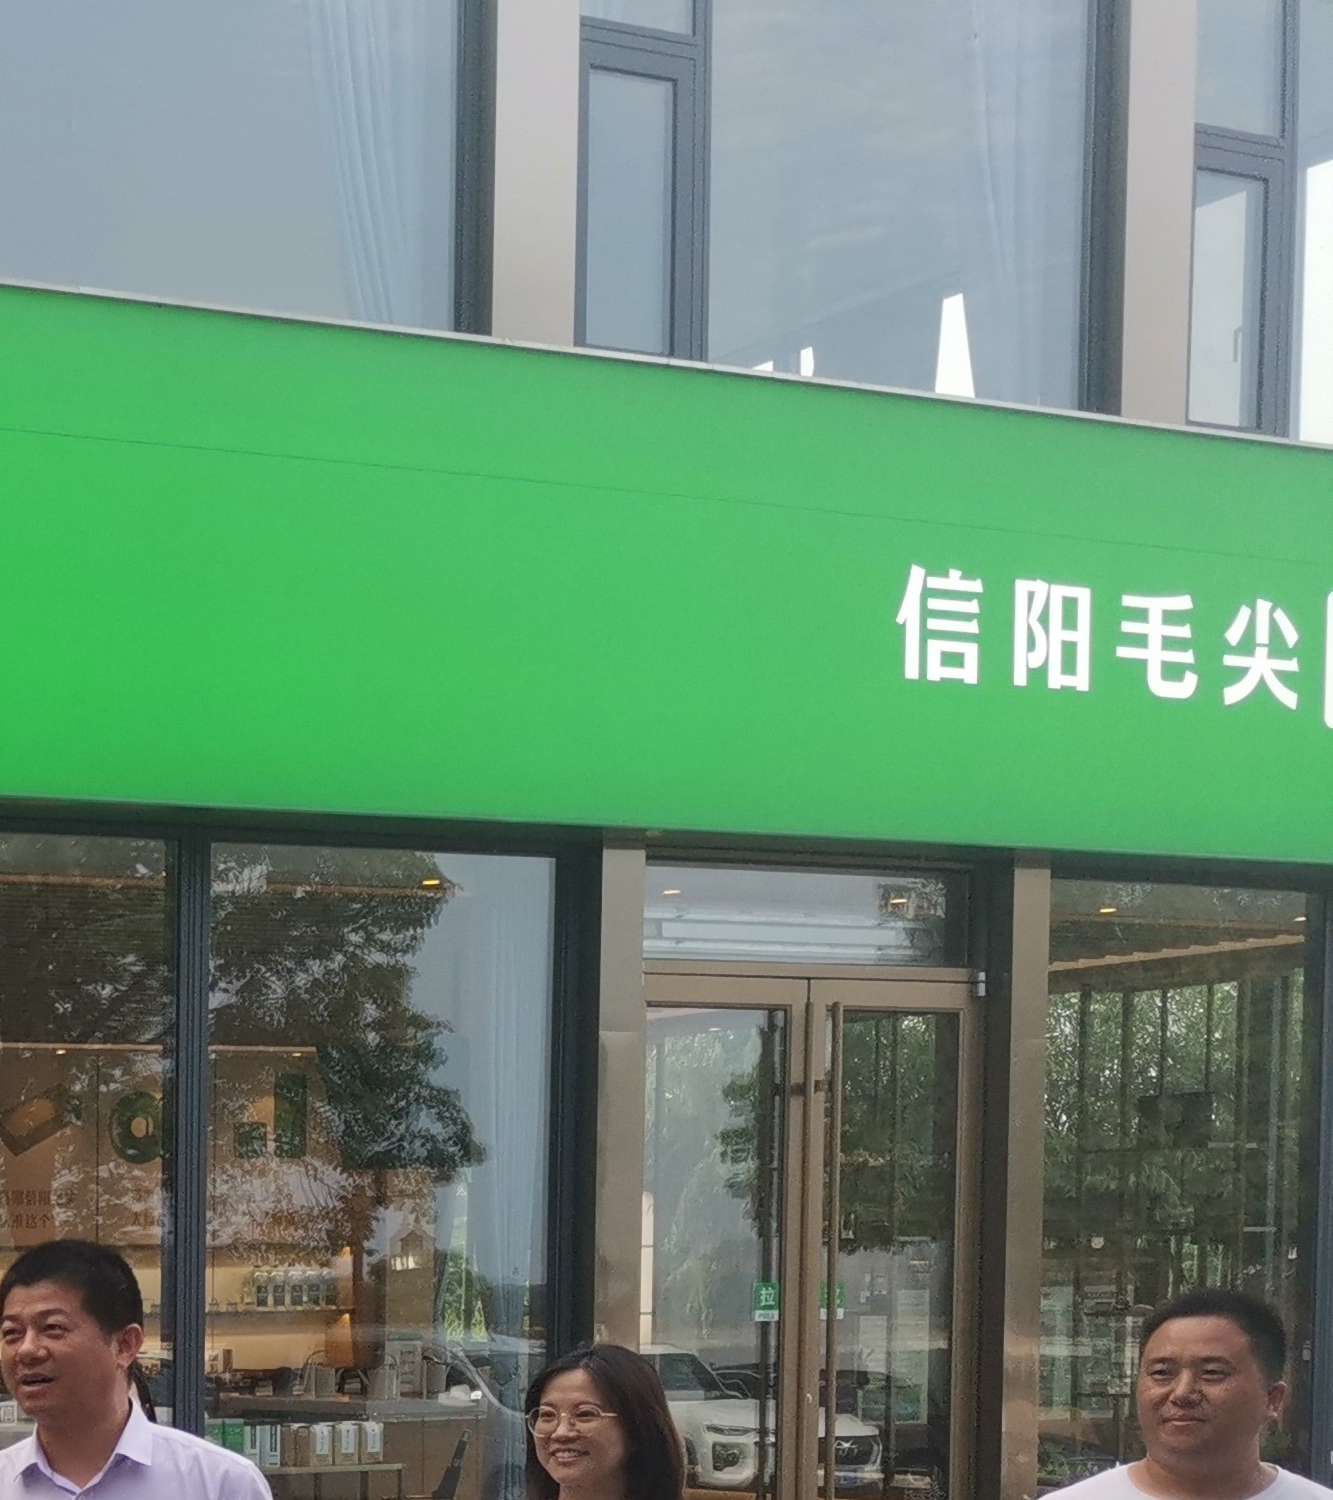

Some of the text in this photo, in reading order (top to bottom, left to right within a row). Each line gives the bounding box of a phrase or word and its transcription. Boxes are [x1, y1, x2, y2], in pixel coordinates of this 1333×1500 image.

[895, 564, 1300, 711] 信阳毛尖
[759, 1286, 776, 1306] 拉
